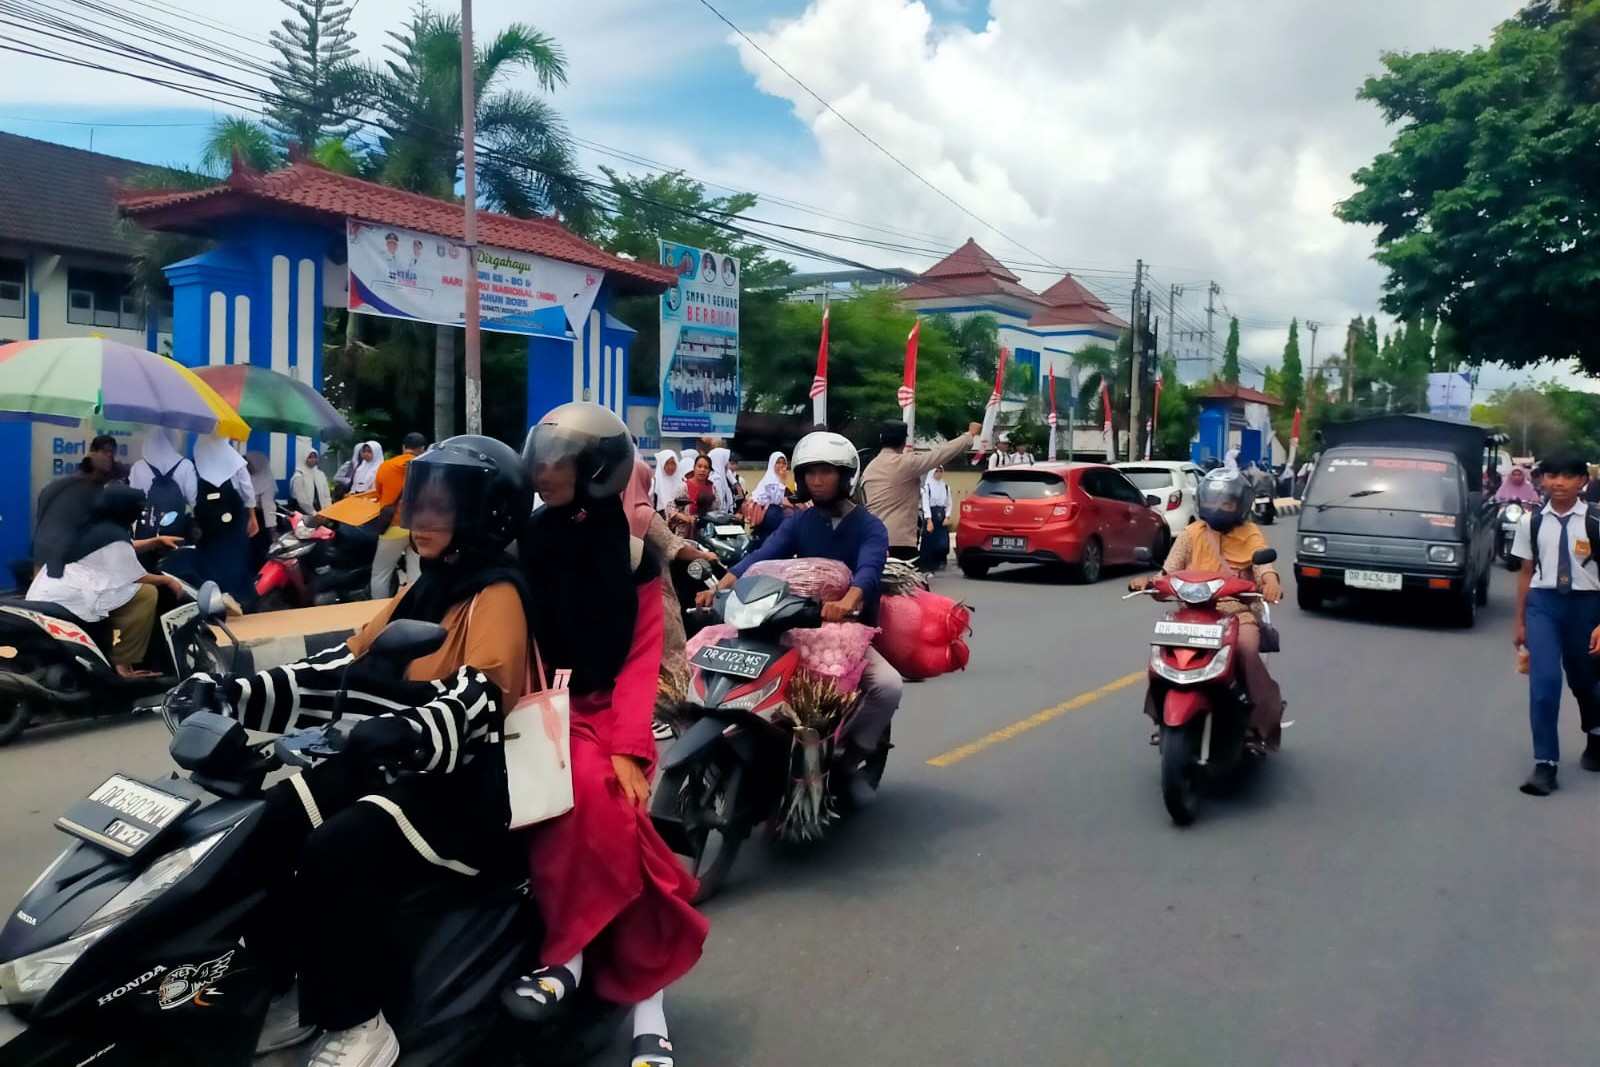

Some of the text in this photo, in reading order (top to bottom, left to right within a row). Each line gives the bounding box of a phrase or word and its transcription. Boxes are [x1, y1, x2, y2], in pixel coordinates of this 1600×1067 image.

[477, 250, 530, 273] Dirgahayu
[479, 293, 504, 305] AHUN
[703, 649, 762, 666] DR 4122 MS
[97, 964, 168, 1006] HONDA
